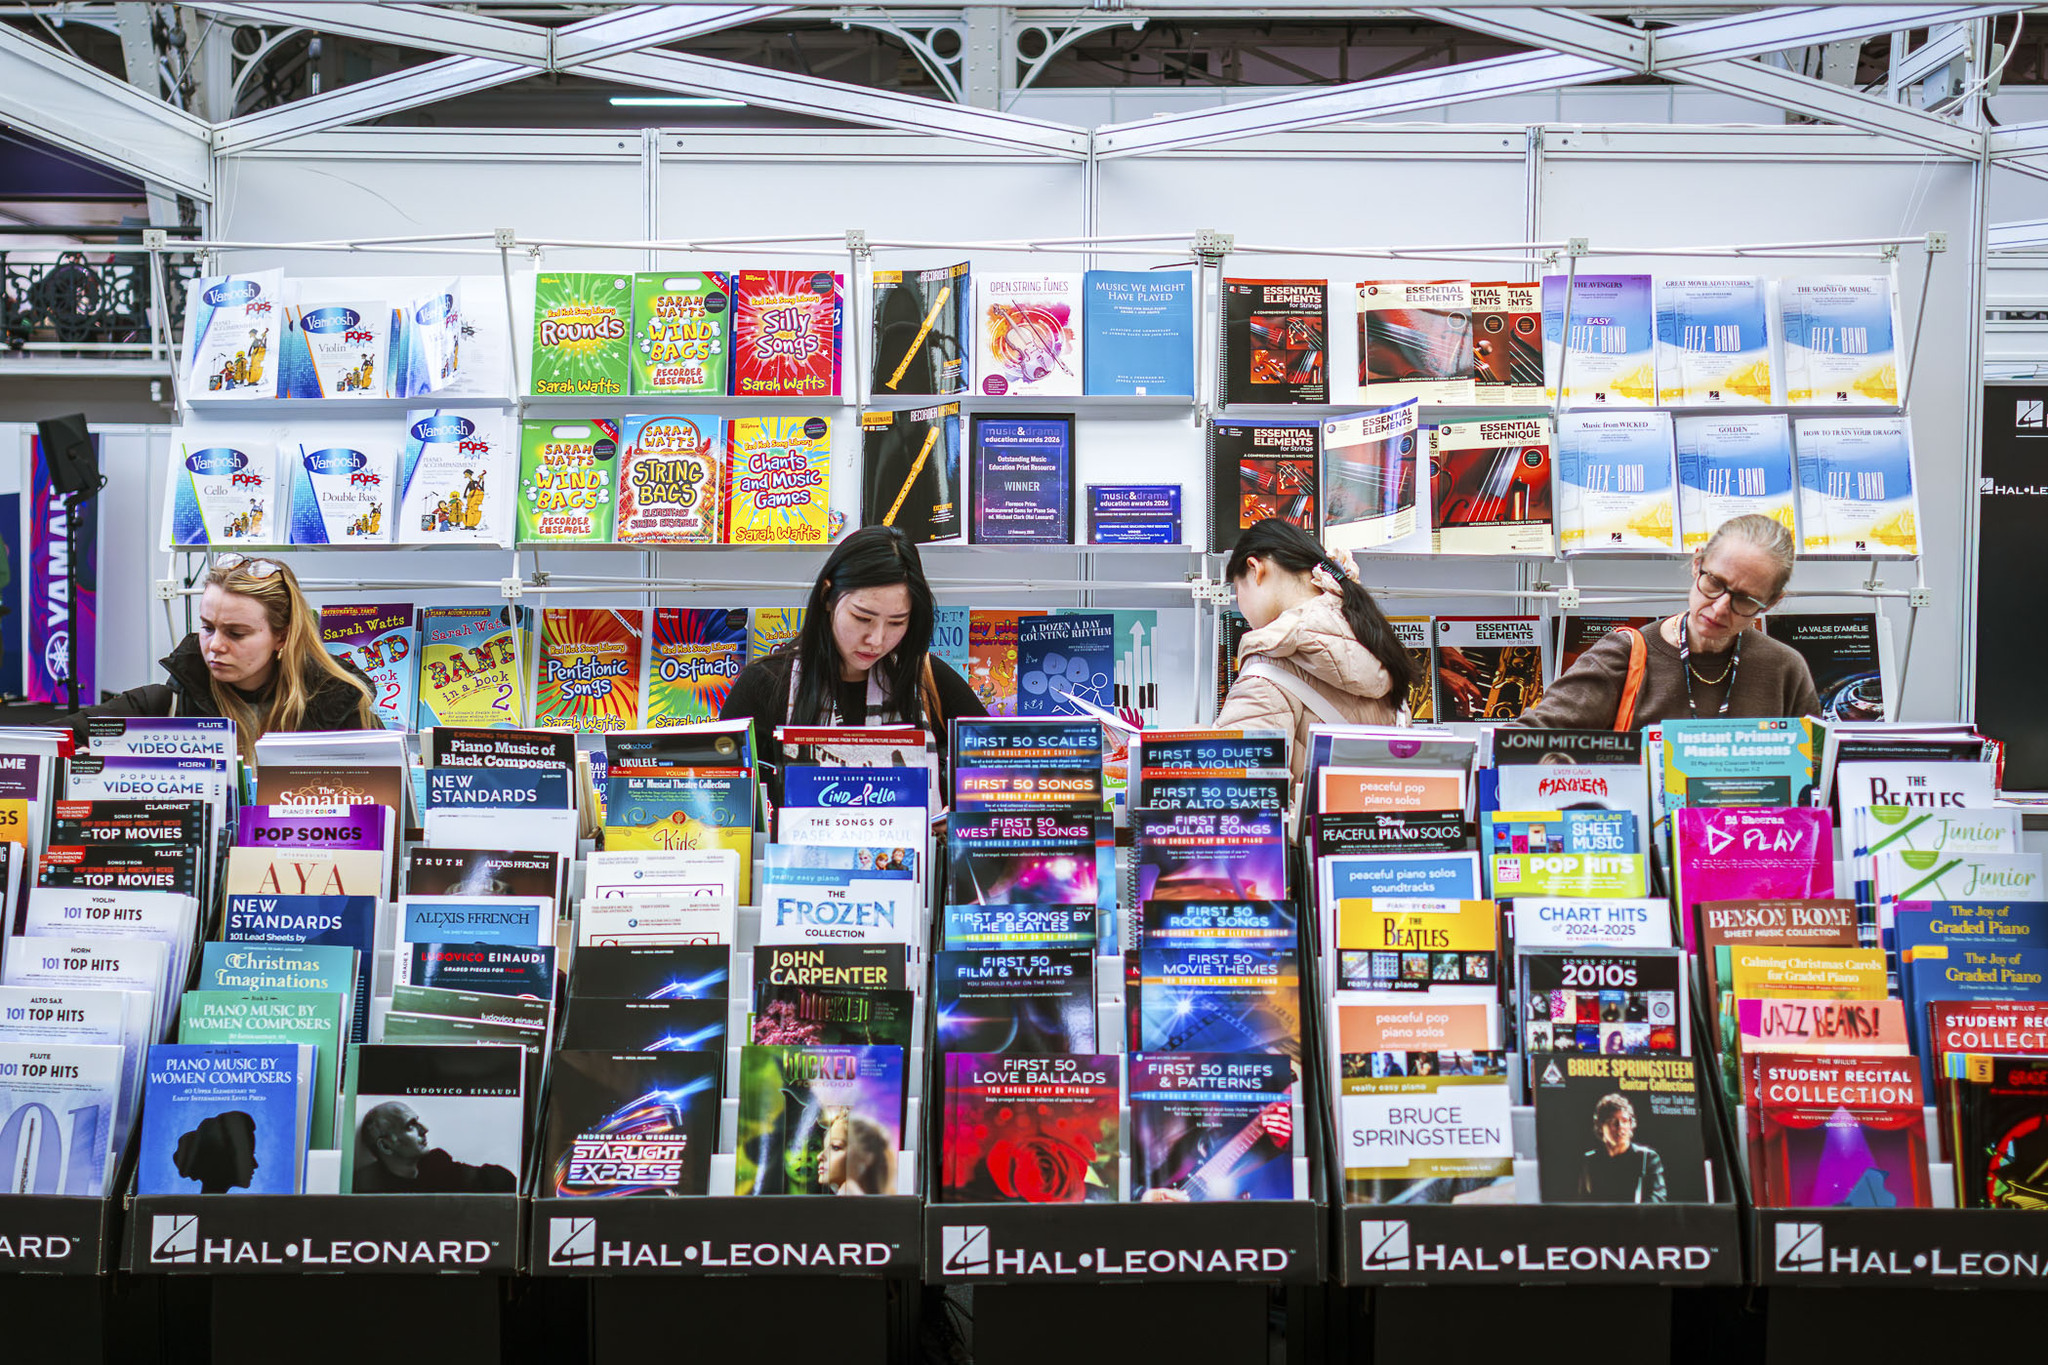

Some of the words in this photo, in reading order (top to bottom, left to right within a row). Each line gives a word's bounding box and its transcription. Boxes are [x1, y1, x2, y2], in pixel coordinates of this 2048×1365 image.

[990, 281, 1011, 292] OPEN
[1013, 281, 1041, 292] STRING
[1043, 281, 1069, 292] TUNES
[1096, 282, 1128, 293] MUSIC
[1131, 283, 1146, 292] WE
[1150, 283, 1185, 293] MIGHT
[1263, 287, 1322, 295] ESSENTIAL
[1589, 281, 1622, 289] AVENGERS
[1108, 291, 1134, 301] HAVE
[1137, 291, 1173, 301] PLAYED
[1263, 294, 1322, 303] ELEMENTS
[305, 311, 355, 331] Vamoosh
[763, 308, 810, 336] Silly
[1586, 317, 1611, 325] EASY
[541, 316, 624, 346] Rounds
[649, 322, 712, 341] WIND
[318, 344, 347, 352] Violin
[650, 340, 710, 361] BAGS
[756, 336, 817, 359] Songs
[537, 379, 575, 394] Sarah
[578, 378, 620, 393] Watts
[1480, 421, 1540, 431] ESSENTIAL
[1480, 429, 1540, 439] TECHNIQUE
[749, 453, 806, 473] Chants
[998, 456, 1029, 464] Outstanding
[633, 461, 702, 484] STRING
[741, 478, 770, 492] and
[772, 470, 822, 489] Music
[1004, 482, 1040, 491] WINNER
[204, 486, 228, 496] Cello
[322, 492, 355, 502] Double
[358, 492, 377, 502] Bass
[639, 484, 696, 506] BAGS
[754, 491, 811, 508] Games
[1031, 623, 1038, 631] A
[1040, 621, 1070, 631] DOZEN
[1072, 620, 1079, 629] A
[1081, 619, 1100, 629] DAY
[1834, 624, 1869, 632] D'AMÉLIE
[1020, 629, 1068, 642] COUNTING
[1070, 627, 1112, 639] RHYTHM
[546, 656, 629, 682] Pentatonic
[659, 658, 740, 682] Ostinato
[442, 692, 451, 702] in
[462, 683, 470, 693] a
[474, 671, 510, 687] book
[561, 677, 612, 700] Songs
[492, 684, 513, 710] 2
[965, 737, 1007, 746] FIRST
[1012, 737, 1033, 746] 50
[1038, 737, 1098, 746] SCALES
[1502, 734, 1545, 748] JONI
[1550, 735, 1635, 750] MITCHELL
[1678, 731, 1731, 744] Instant
[1735, 731, 1796, 745] Primary
[128, 743, 177, 753] VIDEO
[180, 743, 224, 753] GAME
[451, 741, 492, 752] Piano
[494, 742, 538, 754] Music
[540, 744, 555, 755] of
[441, 754, 481, 766] Black
[484, 757, 566, 769] Composers
[620, 758, 657, 767] UKULELE
[432, 775, 473, 787] NEW
[628, 779, 646, 790] Kids'
[648, 779, 671, 789] Musical
[673, 779, 697, 789] Theatre
[699, 780, 730, 789] Collection
[432, 789, 537, 802] STANDARDS
[1153, 788, 1197, 797] FIRST
[1202, 788, 1222, 797] 50
[1226, 787, 1277, 797] DUETS
[1360, 782, 1402, 793] peaceful
[1405, 784, 1425, 795] pop
[1150, 800, 1178, 809] FOR
[1186, 799, 1224, 809] ALTO
[1229, 799, 1279, 809] SAXES
[1365, 796, 1392, 805] piano
[1395, 795, 1421, 805] solos
[92, 829, 122, 839] TOP
[125, 829, 182, 839] MOVIES
[254, 827, 293, 840] POP
[297, 828, 362, 840] SONGS
[956, 828, 998, 837] WEST
[1003, 827, 1034, 837] END
[1039, 827, 1089, 837] SONGS
[1743, 829, 1803, 851] PLAY
[416, 858, 463, 866] TRUTH
[1530, 858, 1581, 874] POP
[1584, 858, 1634, 873] HITS
[1964, 864, 2036, 896] Junior
[64, 908, 81, 918] 101
[86, 908, 111, 919] TOP
[113, 909, 142, 920] HITS
[415, 912, 465, 928] ALEXIS
[467, 912, 530, 924] FFRENCH
[776, 898, 896, 928] FROZEN
[1539, 908, 1602, 922] CHART
[1608, 908, 1647, 921] HITS
[1708, 910, 1787, 929] BENSON
[1792, 909, 1851, 926] BOONE
[805, 929, 865, 938] COLLECTION
[1383, 918, 1449, 950] BEATLES
[1930, 921, 1986, 935] Graded
[1990, 922, 2031, 935] Piano
[225, 953, 320, 971] Christmas
[771, 950, 824, 970] JOHN
[1741, 957, 1785, 971] Calming
[1787, 958, 1843, 970] Christmas
[1846, 959, 1882, 971] Carols
[215, 969, 328, 992] Imaginations
[770, 967, 887, 985] CARPENTER
[1562, 966, 1638, 986] 2010s
[1763, 1004, 1809, 1036] JAZZ
[1814, 1006, 1880, 1038] BEANS!
[166, 1059, 210, 1070] PIANO
[213, 1058, 257, 1070] MUSIC
[260, 1058, 279, 1069] BY
[783, 1050, 856, 1085] WICKED
[151, 1072, 207, 1084] WOMEN
[210, 1071, 292, 1084] COMPOSERS
[974, 1072, 1021, 1084] LOVE
[1026, 1072, 1106, 1084] BALLADS
[1769, 1069, 1838, 1081] STUDENT
[1846, 1070, 1911, 1082] RECITAL
[407, 1087, 463, 1095] LUDOVICO
[1769, 1085, 1913, 1103] COLLECTION
[1389, 1108, 1463, 1124] BRUCE
[1353, 1129, 1500, 1146] SPRINGSTEEN
[574, 1146, 684, 1161] STARLIGHT
[568, 1165, 681, 1182] EXPRESS
